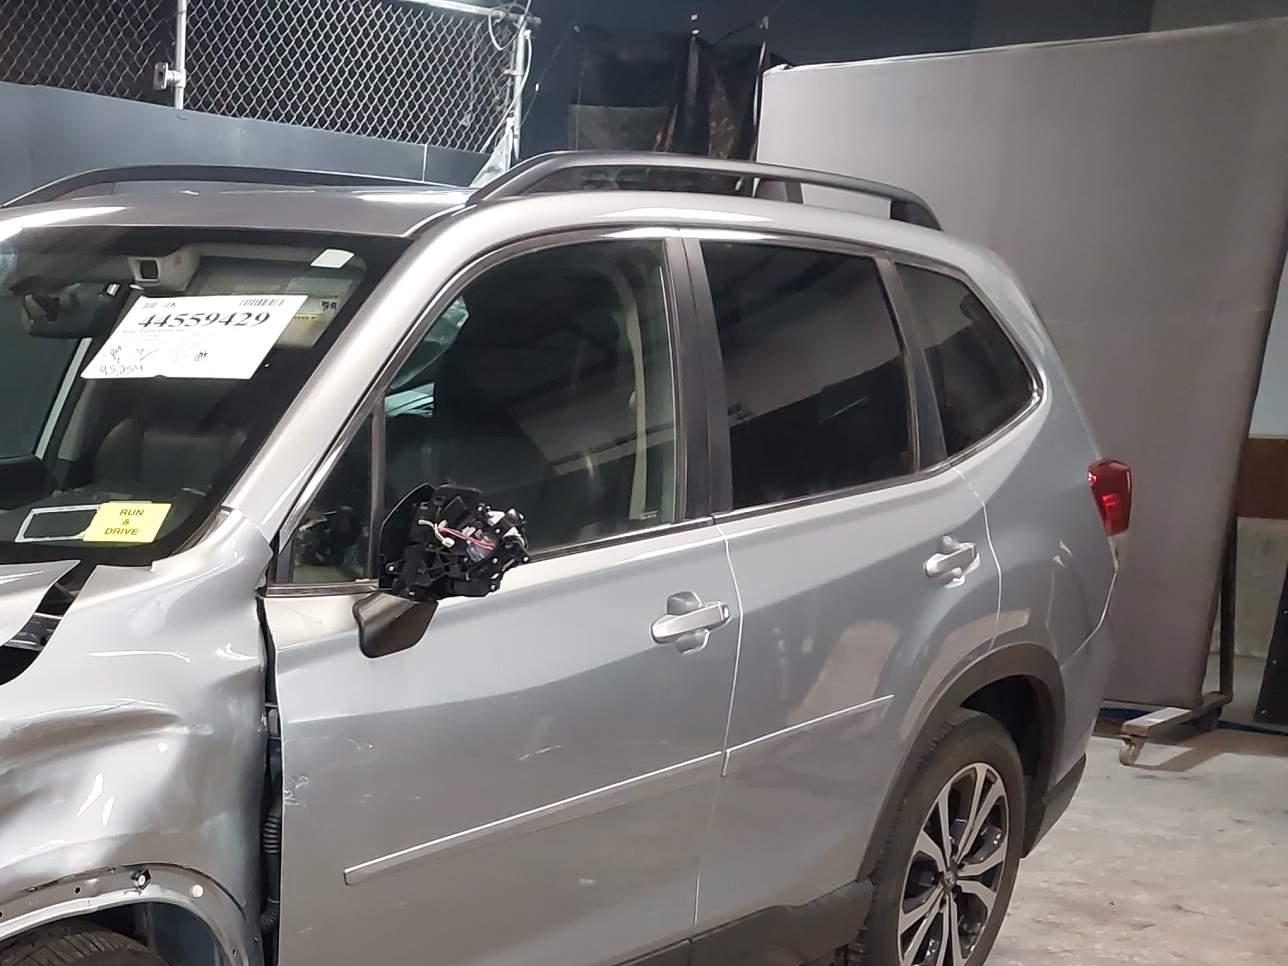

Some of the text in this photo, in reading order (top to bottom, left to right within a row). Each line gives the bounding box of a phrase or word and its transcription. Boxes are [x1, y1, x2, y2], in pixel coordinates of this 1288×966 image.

[138, 311, 271, 328] 44559429
[119, 508, 144, 516] RUN
[104, 527, 139, 536] DRIVE
